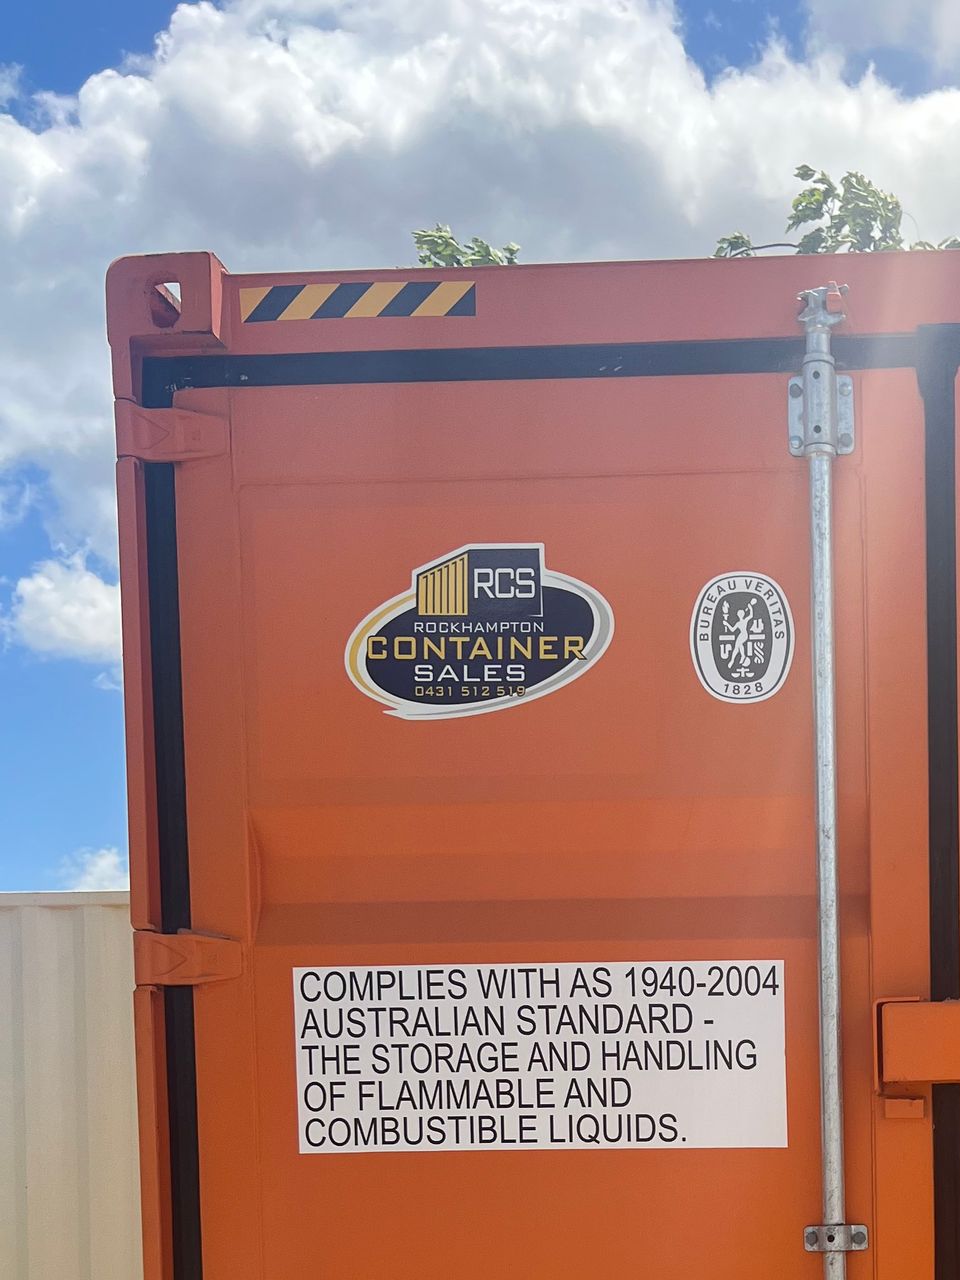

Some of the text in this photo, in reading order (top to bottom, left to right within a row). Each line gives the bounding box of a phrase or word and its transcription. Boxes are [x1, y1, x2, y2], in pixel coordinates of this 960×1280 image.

[473, 568, 535, 599] RCS
[699, 579, 785, 641] BUREAU VERITAS
[414, 621, 544, 633] ROCKHAMPTON
[367, 636, 587, 660] CONTAINER
[414, 664, 525, 682] SALES
[724, 682, 763, 695] 1828
[414, 685, 527, 697] 0431 512 519
[300, 965, 780, 1002] COMPLIES WITH AS 1940-2004
[301, 1005, 504, 1039] AUSTRALIAN
[517, 1003, 693, 1036] STANDARD
[301, 1039, 757, 1075] THE STORAGE AND HANDLING
[304, 1077, 631, 1111] OF FLAMMABLE AND
[305, 1113, 686, 1147] COMBUSTIBLE LIQUIDS.
